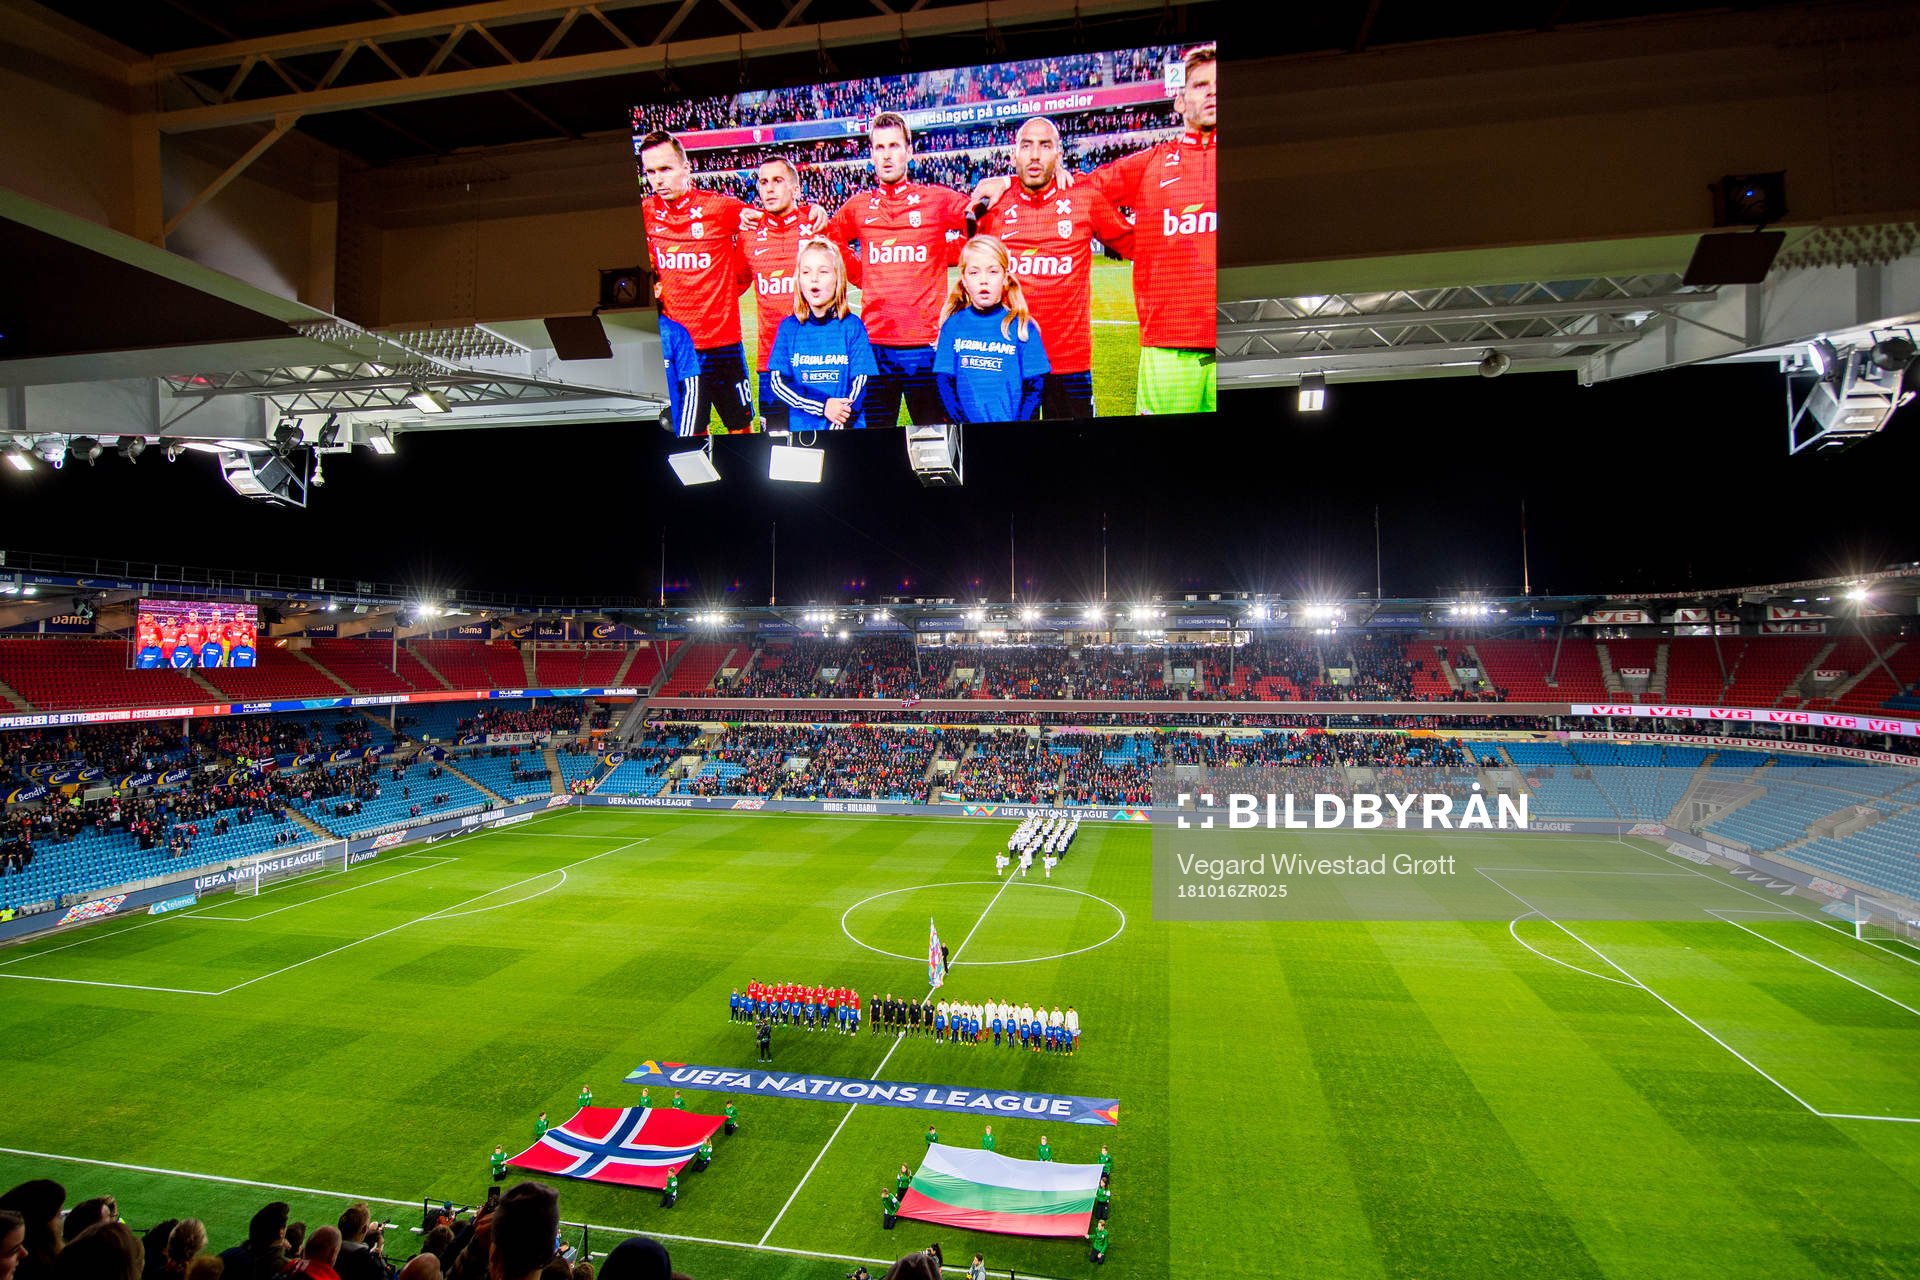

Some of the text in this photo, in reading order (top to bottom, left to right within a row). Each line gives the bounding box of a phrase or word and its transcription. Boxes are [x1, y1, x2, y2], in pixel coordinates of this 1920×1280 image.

[977, 103, 993, 120] på
[996, 101, 1041, 116] sosiale
[1044, 94, 1094, 111] medier
[1163, 207, 1216, 236] bam
[656, 246, 711, 270] bama
[868, 241, 927, 264] bama
[1006, 250, 1072, 276] bama
[758, 272, 794, 295] bam
[969, 357, 1003, 369] RESPECT
[809, 371, 839, 382] RESPECT
[735, 380, 751, 406] 18
[1592, 610, 1640, 622] VG
[459, 626, 482, 634] bama
[1592, 705, 1632, 715] VG
[1650, 707, 1692, 716] VG
[1710, 709, 1752, 719] VG
[48, 714, 59, 725] OG
[1769, 711, 1808, 723] VG
[1823, 715, 1856, 728] VG
[1869, 720, 1901, 733] VG
[1747, 740, 1775, 748] VG
[1781, 742, 1807, 751] VG
[1813, 745, 1838, 754] VG
[1842, 749, 1865, 758] VG
[1870, 752, 1890, 762] VG
[1895, 756, 1917, 766] VG
[55, 772, 70, 781] Bendit
[84, 769, 98, 778] Bendit
[165, 769, 187, 782] Bendit
[129, 774, 152, 787] Bendit
[18, 785, 46, 801] Bendit
[607, 796, 692, 807] UEFA NATIONS LEAGUE
[823, 802, 844, 812] NORGE
[848, 803, 877, 812] BULGARIA
[1001, 807, 1108, 819] UEFA NATIONS LEAGUE
[1530, 822, 1571, 831] LEAGUE
[354, 850, 377, 863] bama
[194, 850, 322, 890] UEFA NATIONS LEAGUE
[167, 895, 195, 909] telenor
[667, 1067, 1073, 1117] UEFA NATIONS LEAGUE
